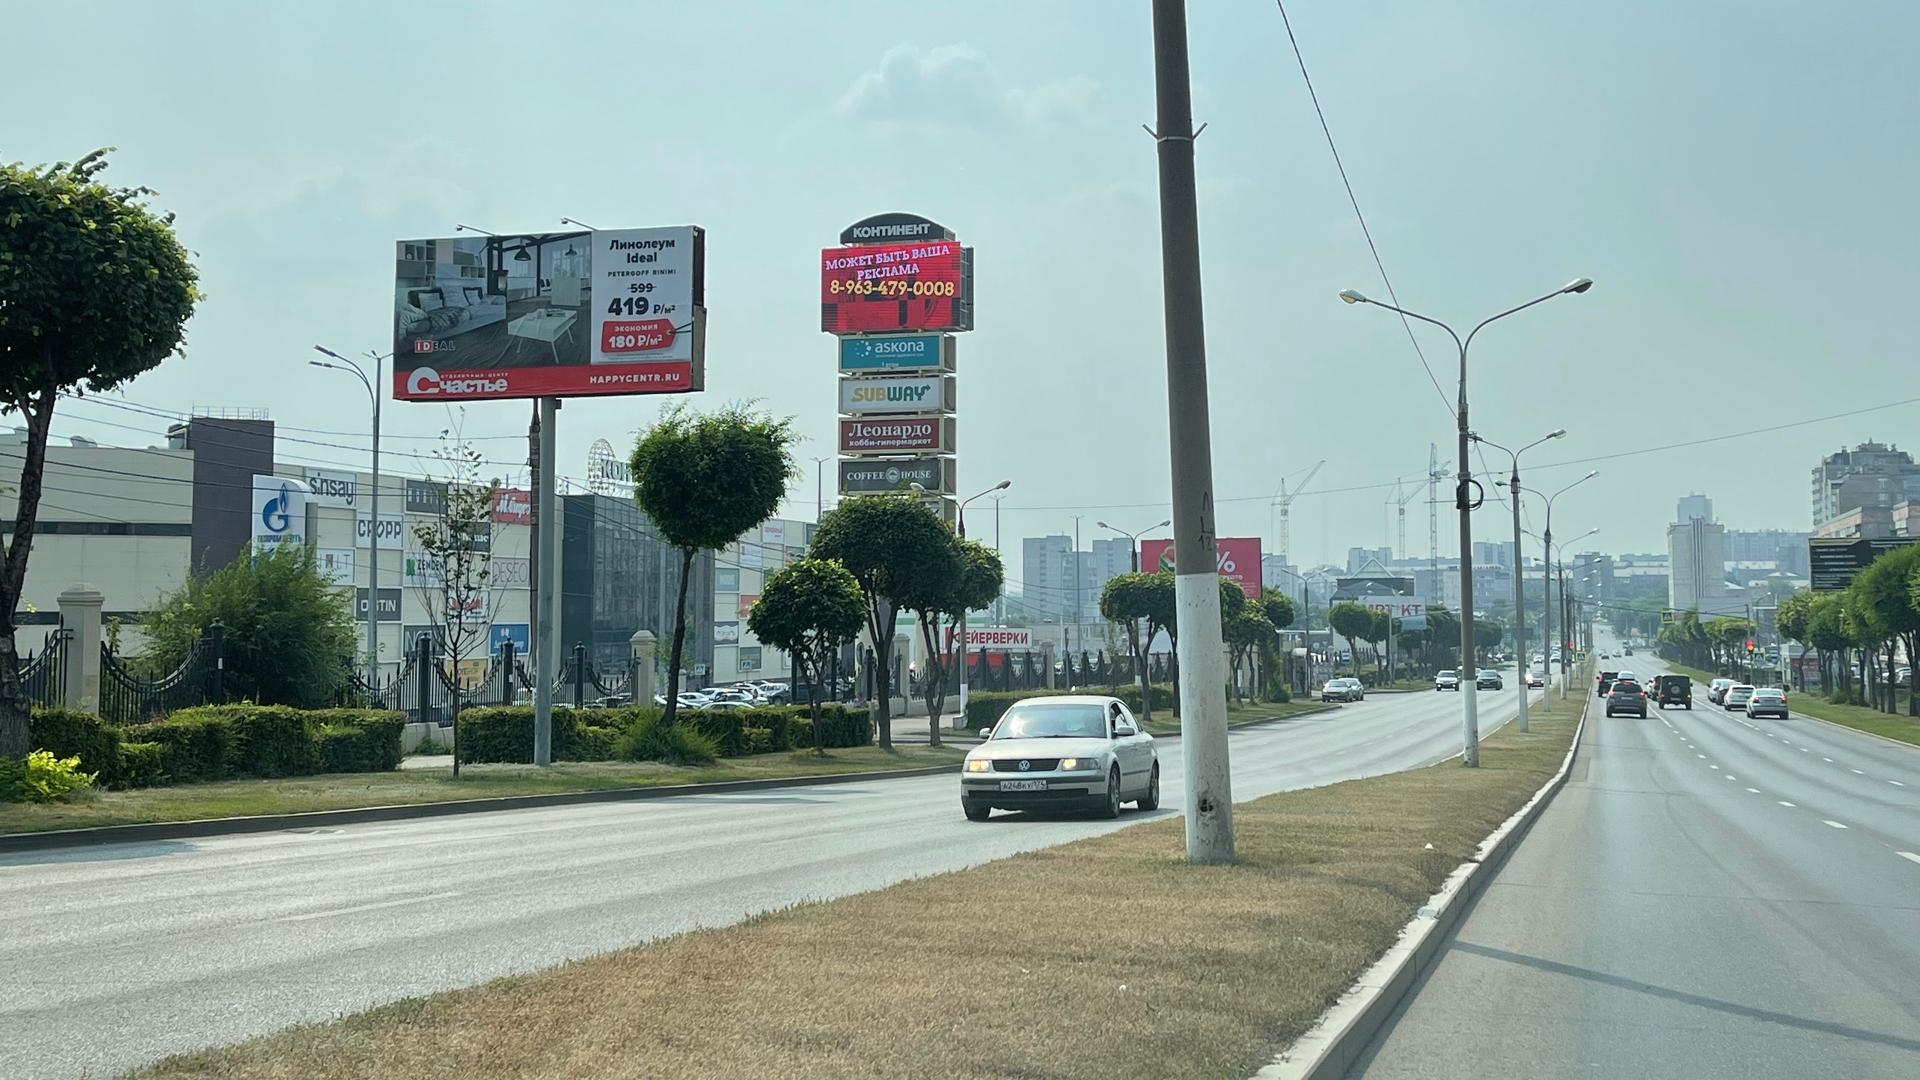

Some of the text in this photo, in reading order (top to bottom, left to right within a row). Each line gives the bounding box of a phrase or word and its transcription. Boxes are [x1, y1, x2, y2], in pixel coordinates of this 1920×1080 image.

[853, 223, 930, 238] КОНТИНЕНТ
[609, 239, 675, 250] Линолеум
[627, 252, 657, 263] Ideal
[825, 245, 950, 271] МОЖЕТ БЫТЬ ВАША
[857, 263, 920, 280] РЕКЛАМА
[630, 283, 653, 293] 599
[830, 280, 954, 297] 8-963-479-0008
[608, 296, 649, 316] 419
[614, 324, 658, 332] ЭКОНОМИЯ
[609, 335, 635, 348] 180
[875, 341, 924, 353] askona
[407, 366, 508, 394] Счастье
[590, 373, 680, 384] HAPPYCENTR.RU
[851, 384, 931, 402] SUBWAY
[849, 423, 931, 439] Леонардо
[849, 438, 931, 447] хобби-гипермаркет
[846, 470, 931, 481] COFFEE HOUSE
